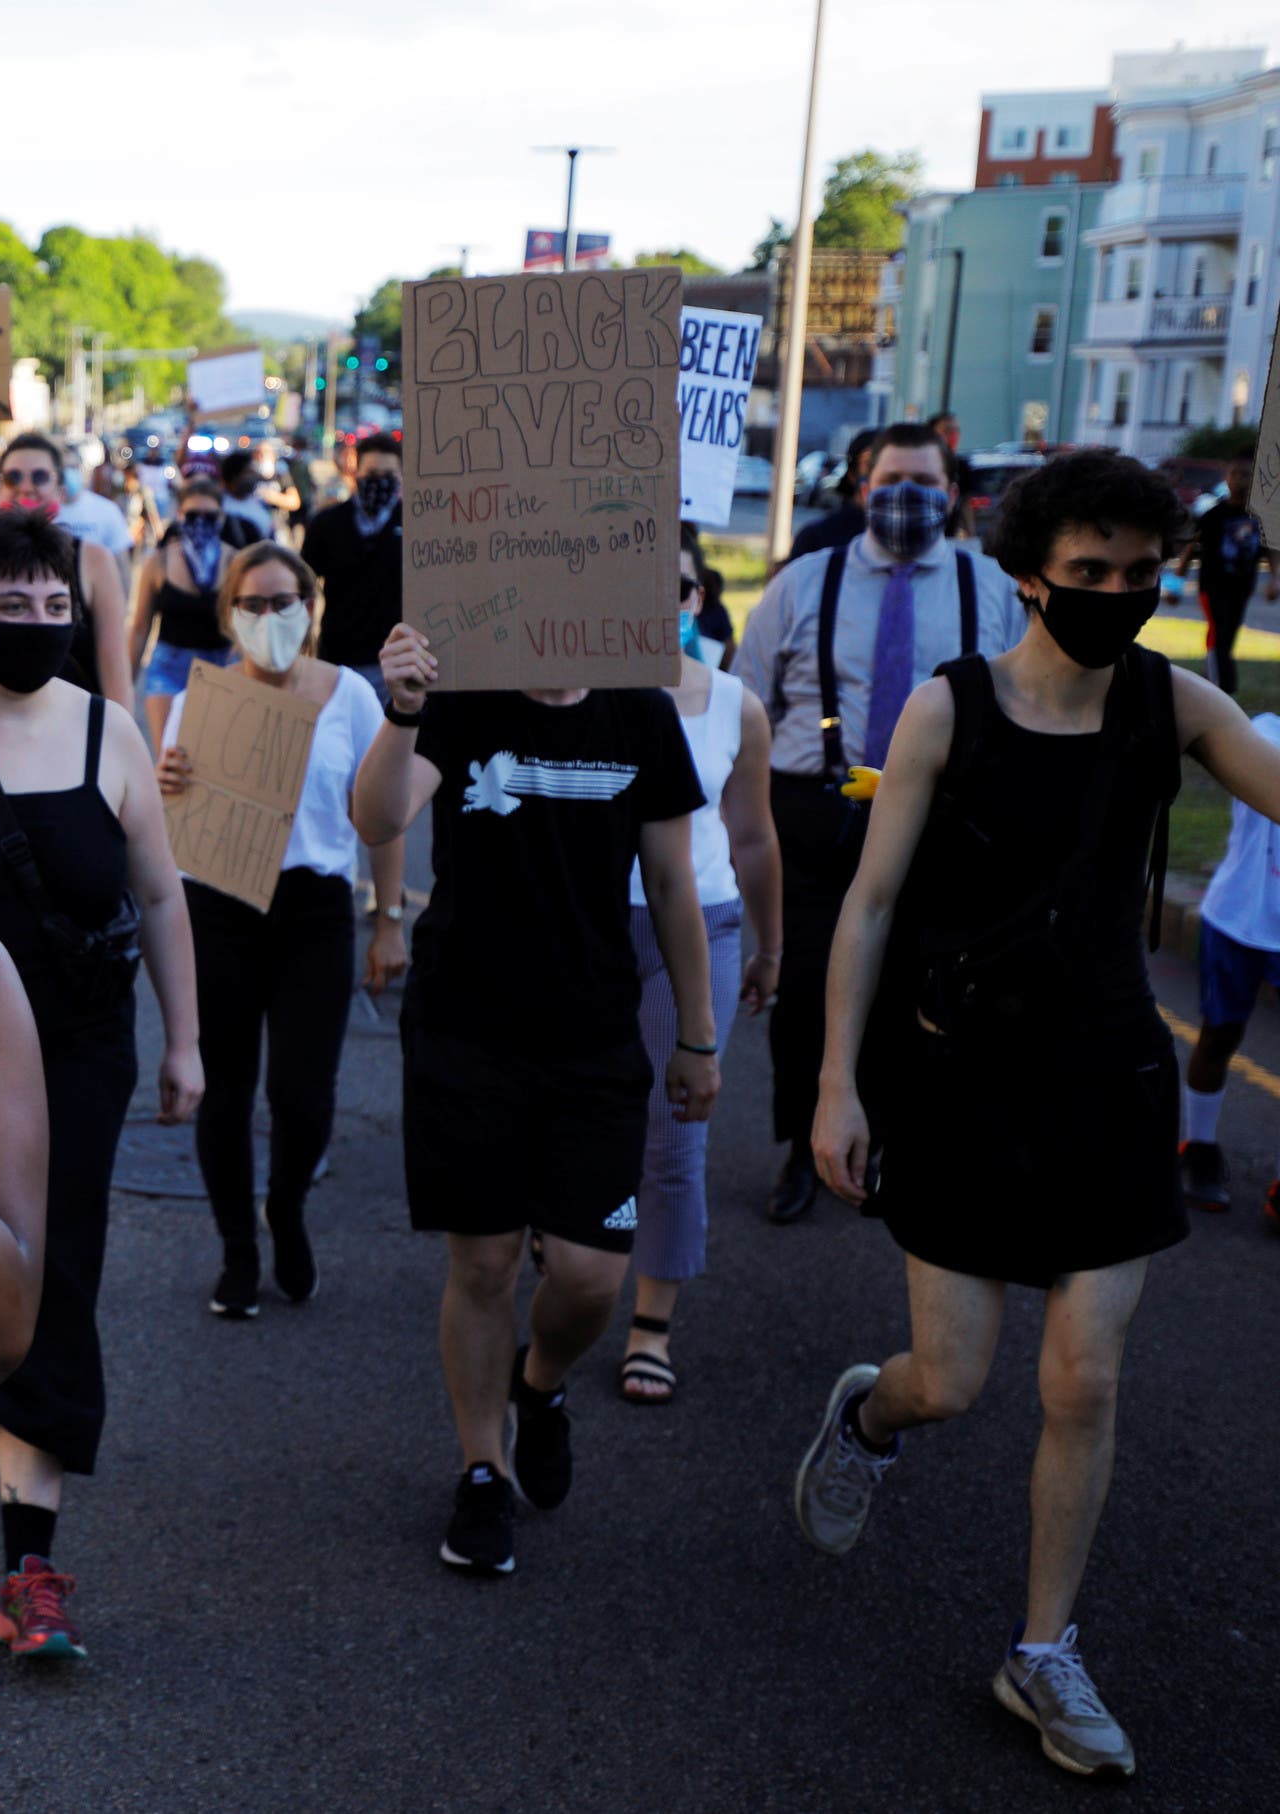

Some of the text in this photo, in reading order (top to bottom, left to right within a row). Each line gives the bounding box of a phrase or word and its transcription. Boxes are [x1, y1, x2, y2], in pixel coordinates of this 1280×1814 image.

[414, 273, 683, 384] BLACK
[680, 318, 760, 382] BEEN
[417, 377, 664, 476] LIVES
[680, 383, 748, 449] YEARS
[451, 483, 510, 525] NOT
[506, 491, 549, 519] the
[560, 475, 665, 511] THREAT
[411, 536, 478, 570] White
[423, 584, 521, 650] Silence
[493, 616, 679, 660] is VIOLENCE
